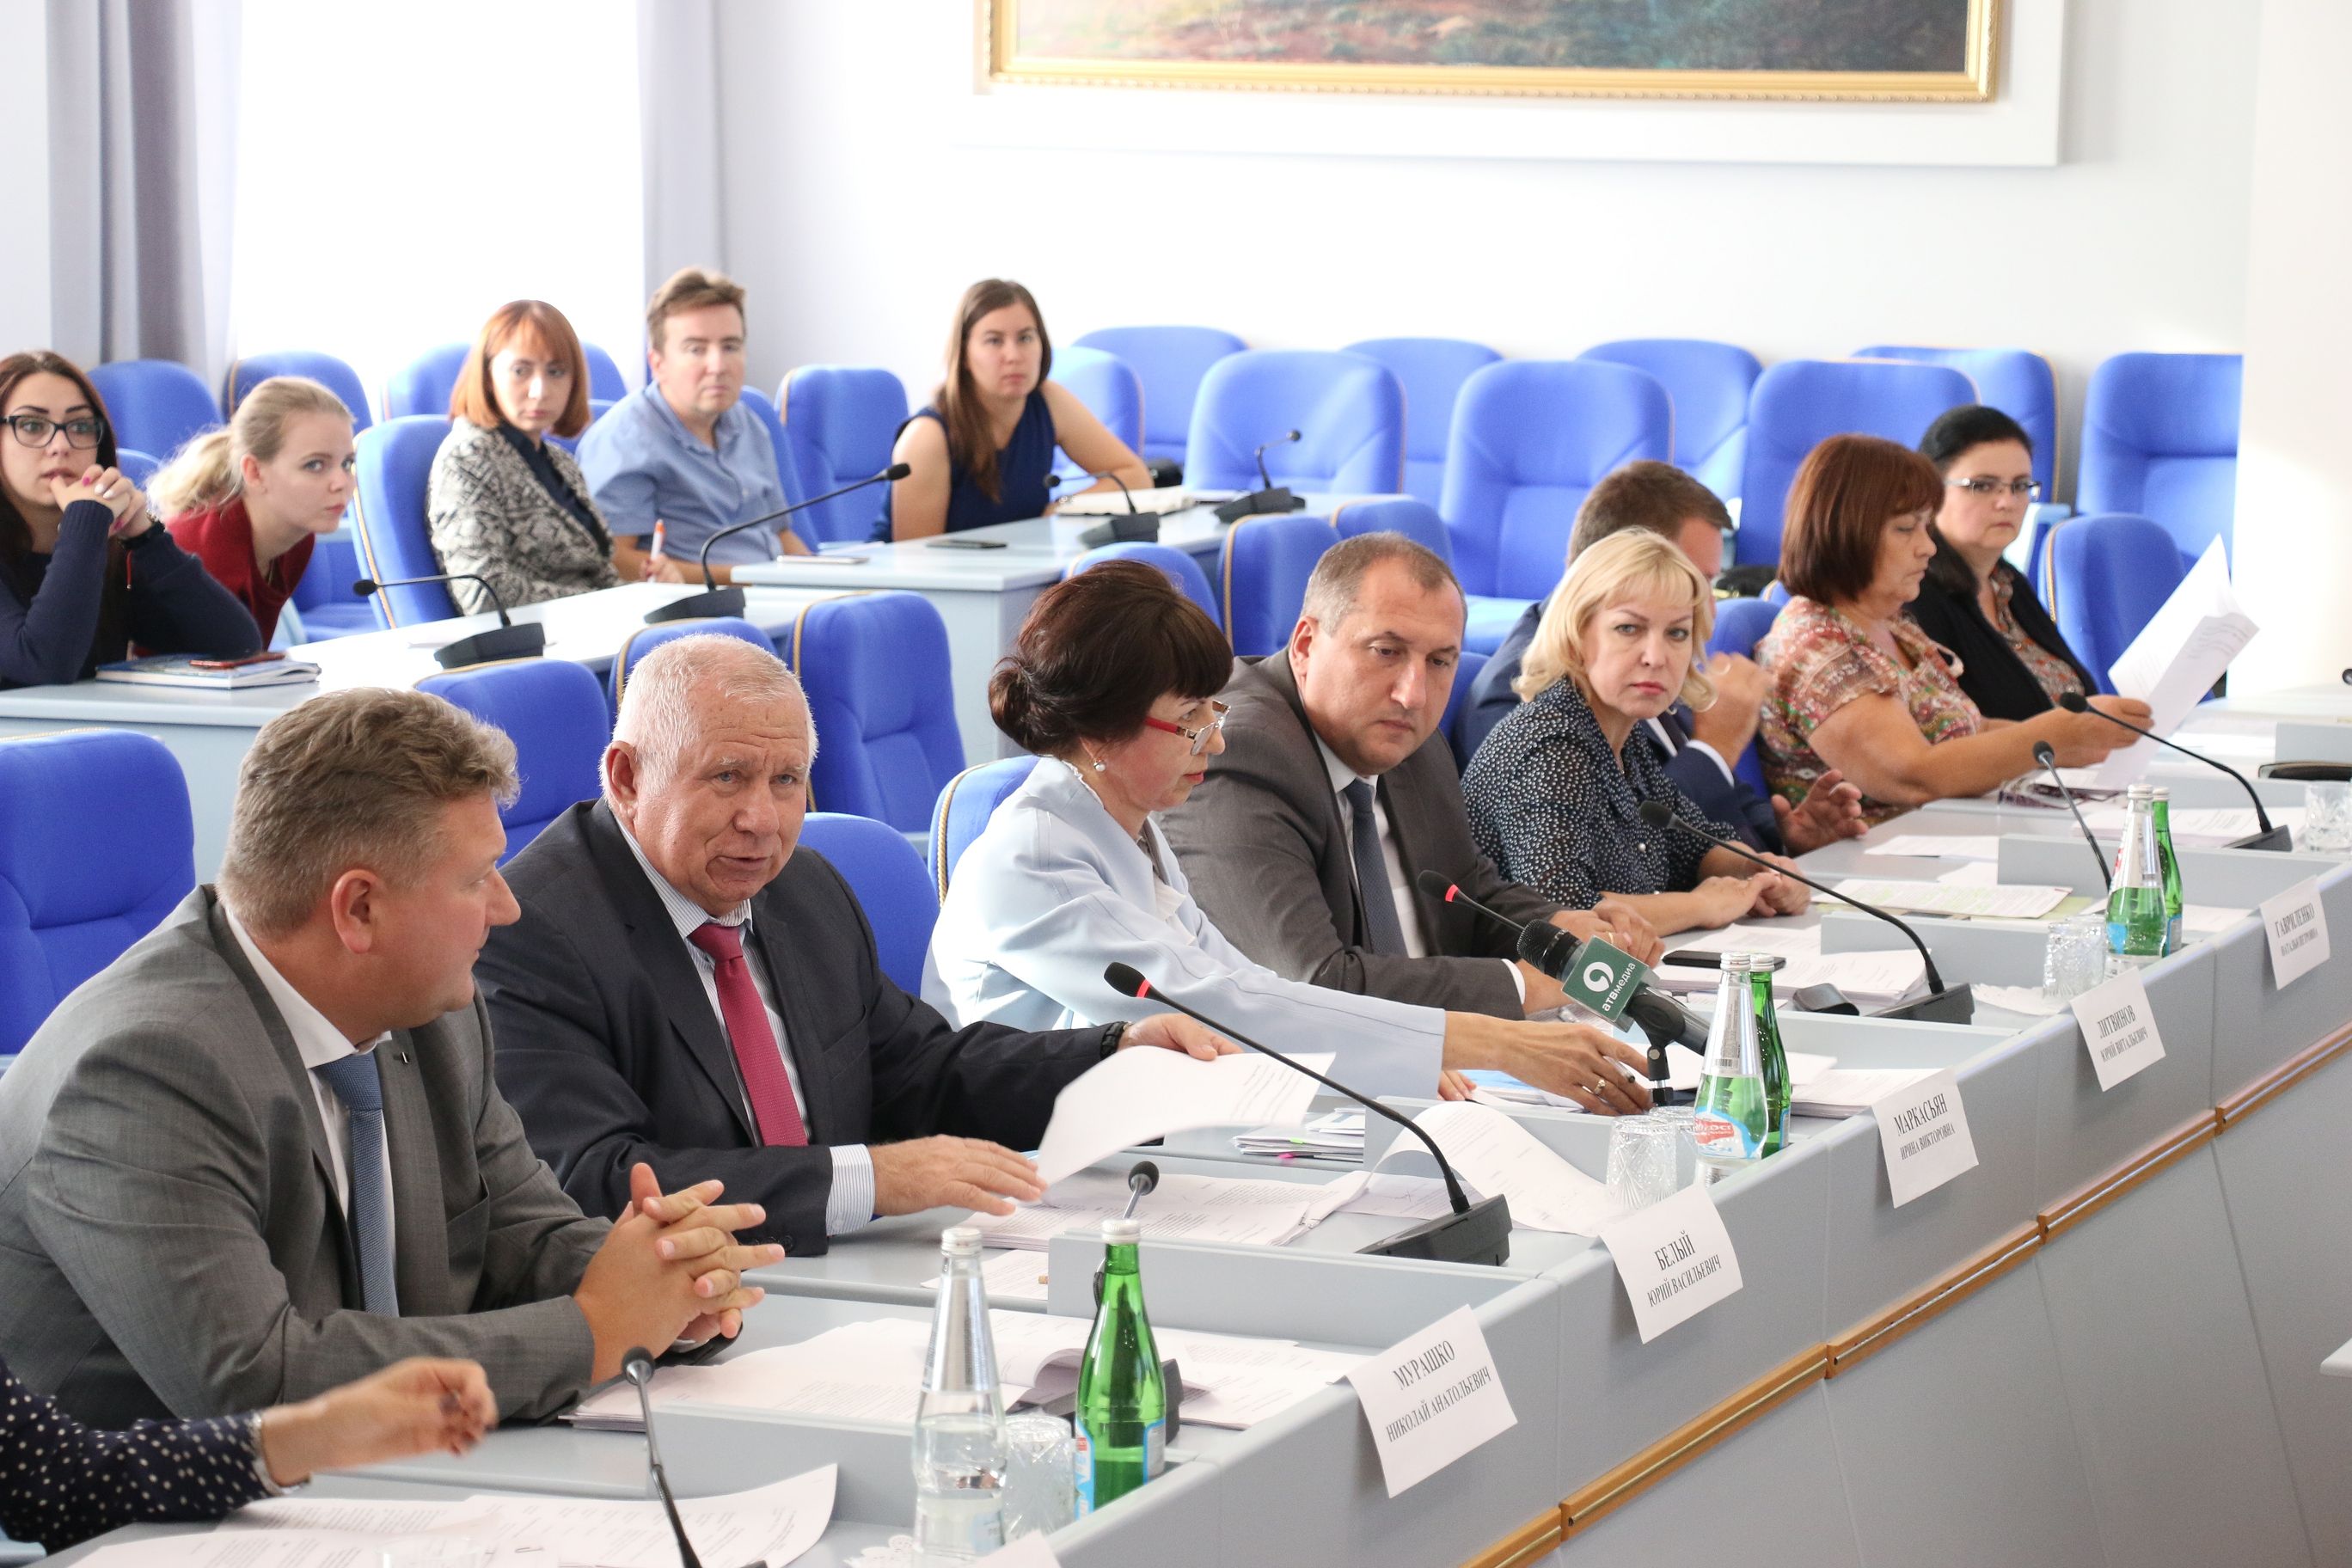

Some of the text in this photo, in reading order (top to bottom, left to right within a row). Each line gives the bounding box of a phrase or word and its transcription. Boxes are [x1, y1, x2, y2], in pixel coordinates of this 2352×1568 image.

[2275, 903, 2315, 938] ГАВРИЛЕНКО
[1602, 962, 1636, 1012] атвмедиа
[2098, 1005, 2135, 1038] ЛИТВИНОВ
[2100, 1026, 2148, 1063] ЮРИЙ ВИТАЛЬЕВИЧ
[1894, 1093, 1948, 1136] МАРКАСЬЯН
[1900, 1122, 1956, 1160] ИРИНА ВИКТОРОВНА
[1654, 1230, 1695, 1271] БЕЛЫЙ
[1647, 1254, 1722, 1308] ЮРИЙ ВАСИЛЬЕВИЧ
[1393, 1339, 1455, 1391] МУРАШКО
[1386, 1366, 1491, 1442] НИКОЛАЙ АНАТОЛЬЕВИЧ
